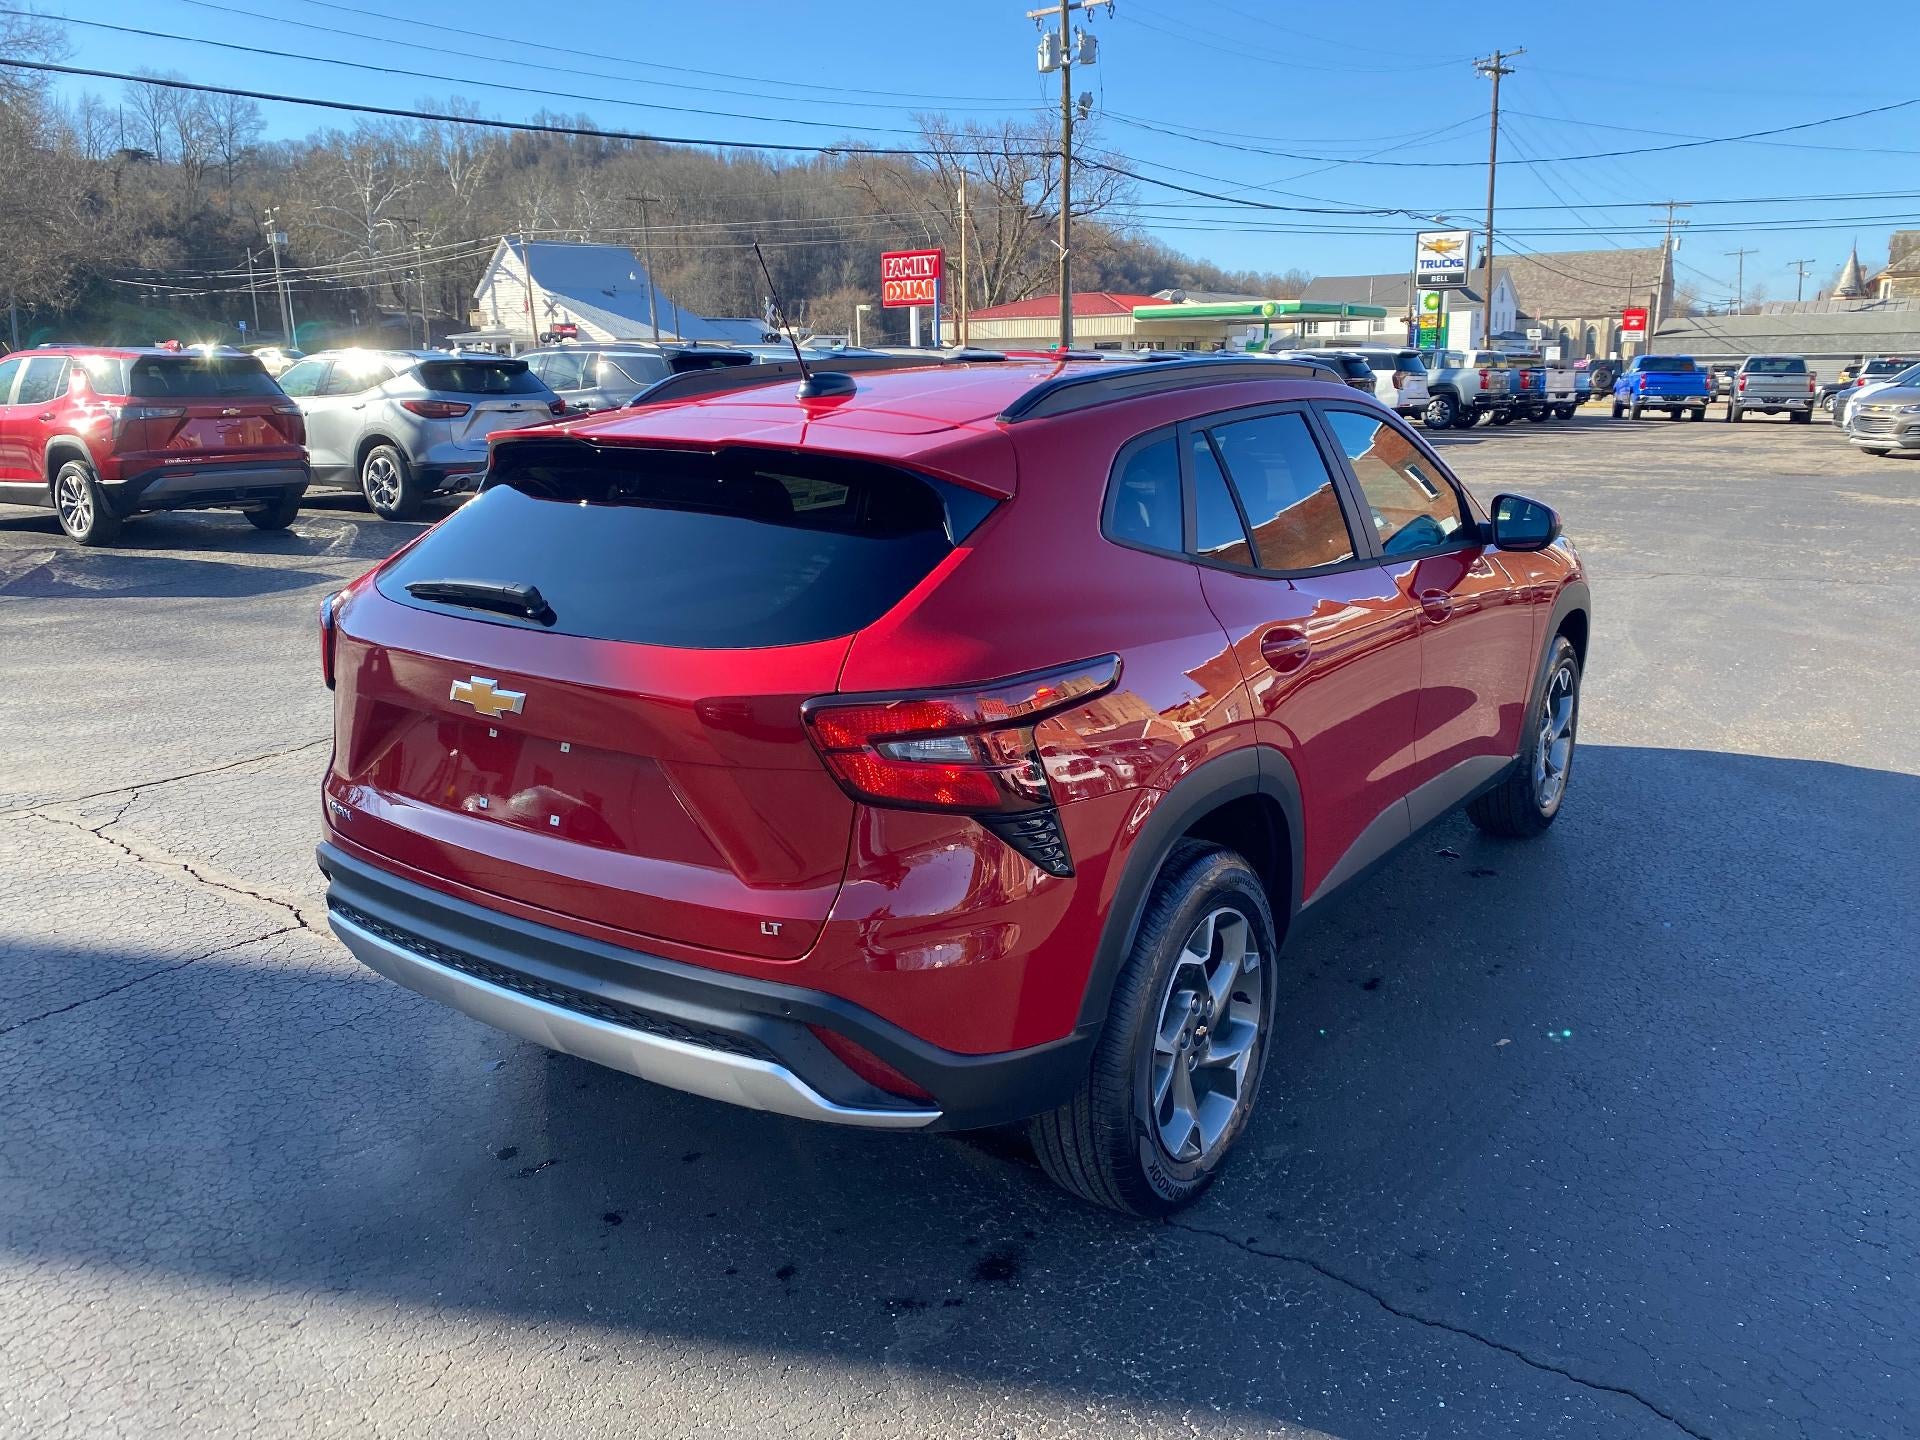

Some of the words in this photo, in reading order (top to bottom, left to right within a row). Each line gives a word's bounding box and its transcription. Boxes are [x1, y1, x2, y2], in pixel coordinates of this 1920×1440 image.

[884, 255, 936, 277] FAMILY
[1420, 259, 1464, 269] TRUCKS
[884, 279, 936, 300] DOLLAR
[760, 921, 783, 936] LT
